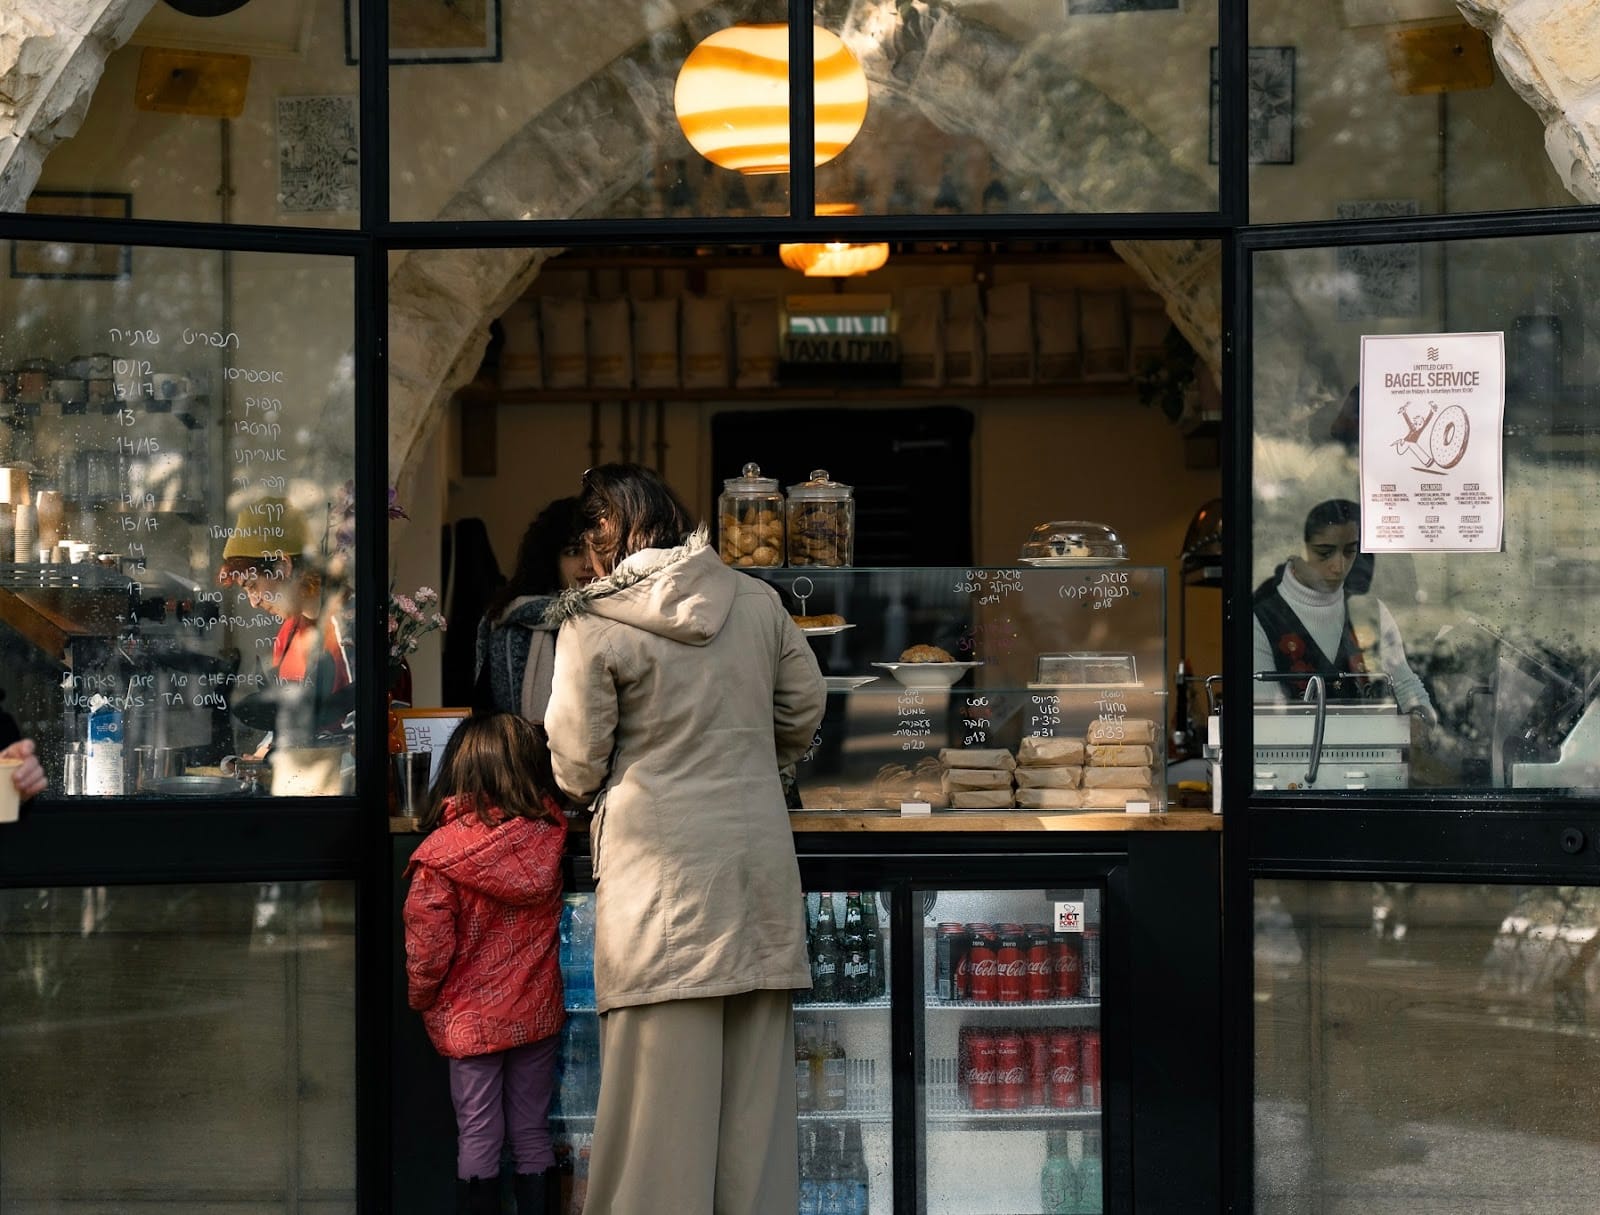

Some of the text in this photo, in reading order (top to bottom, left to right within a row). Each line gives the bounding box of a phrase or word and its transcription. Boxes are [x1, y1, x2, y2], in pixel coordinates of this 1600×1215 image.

[182, 329, 240, 349] תפריט
[112, 359, 153, 376] 10/12
[223, 367, 285, 384] אספרסו
[1384, 371, 1480, 388] BAGEL SERVICE
[112, 382, 154, 396] 15/17
[116, 409, 136, 427] 13
[234, 420, 281, 441] קורטדו
[116, 437, 160, 453] 14/15
[235, 448, 287, 468] אמריקנו
[121, 516, 160, 532] 15/17
[128, 542, 144, 556] 14
[261, 549, 285, 562] תה
[129, 562, 146, 575] 15
[219, 566, 285, 584] תה צמחים
[1093, 572, 1128, 584] עוגת
[127, 581, 144, 596] 17
[989, 581, 1024, 597] שוקולד
[1078, 585, 1129, 599] תפוחים
[62, 672, 115, 689] Drinks
[131, 673, 154, 689] are
[198, 673, 264, 688] CHEAPER
[161, 692, 185, 706] TA
[192, 692, 228, 710] only
[1032, 695, 1060, 705] בריוש
[1040, 705, 1060, 715] סלט
[1032, 715, 1061, 726] ביצים
[1099, 713, 1125, 726] MELT
[1059, 913, 1080, 921] HOT
